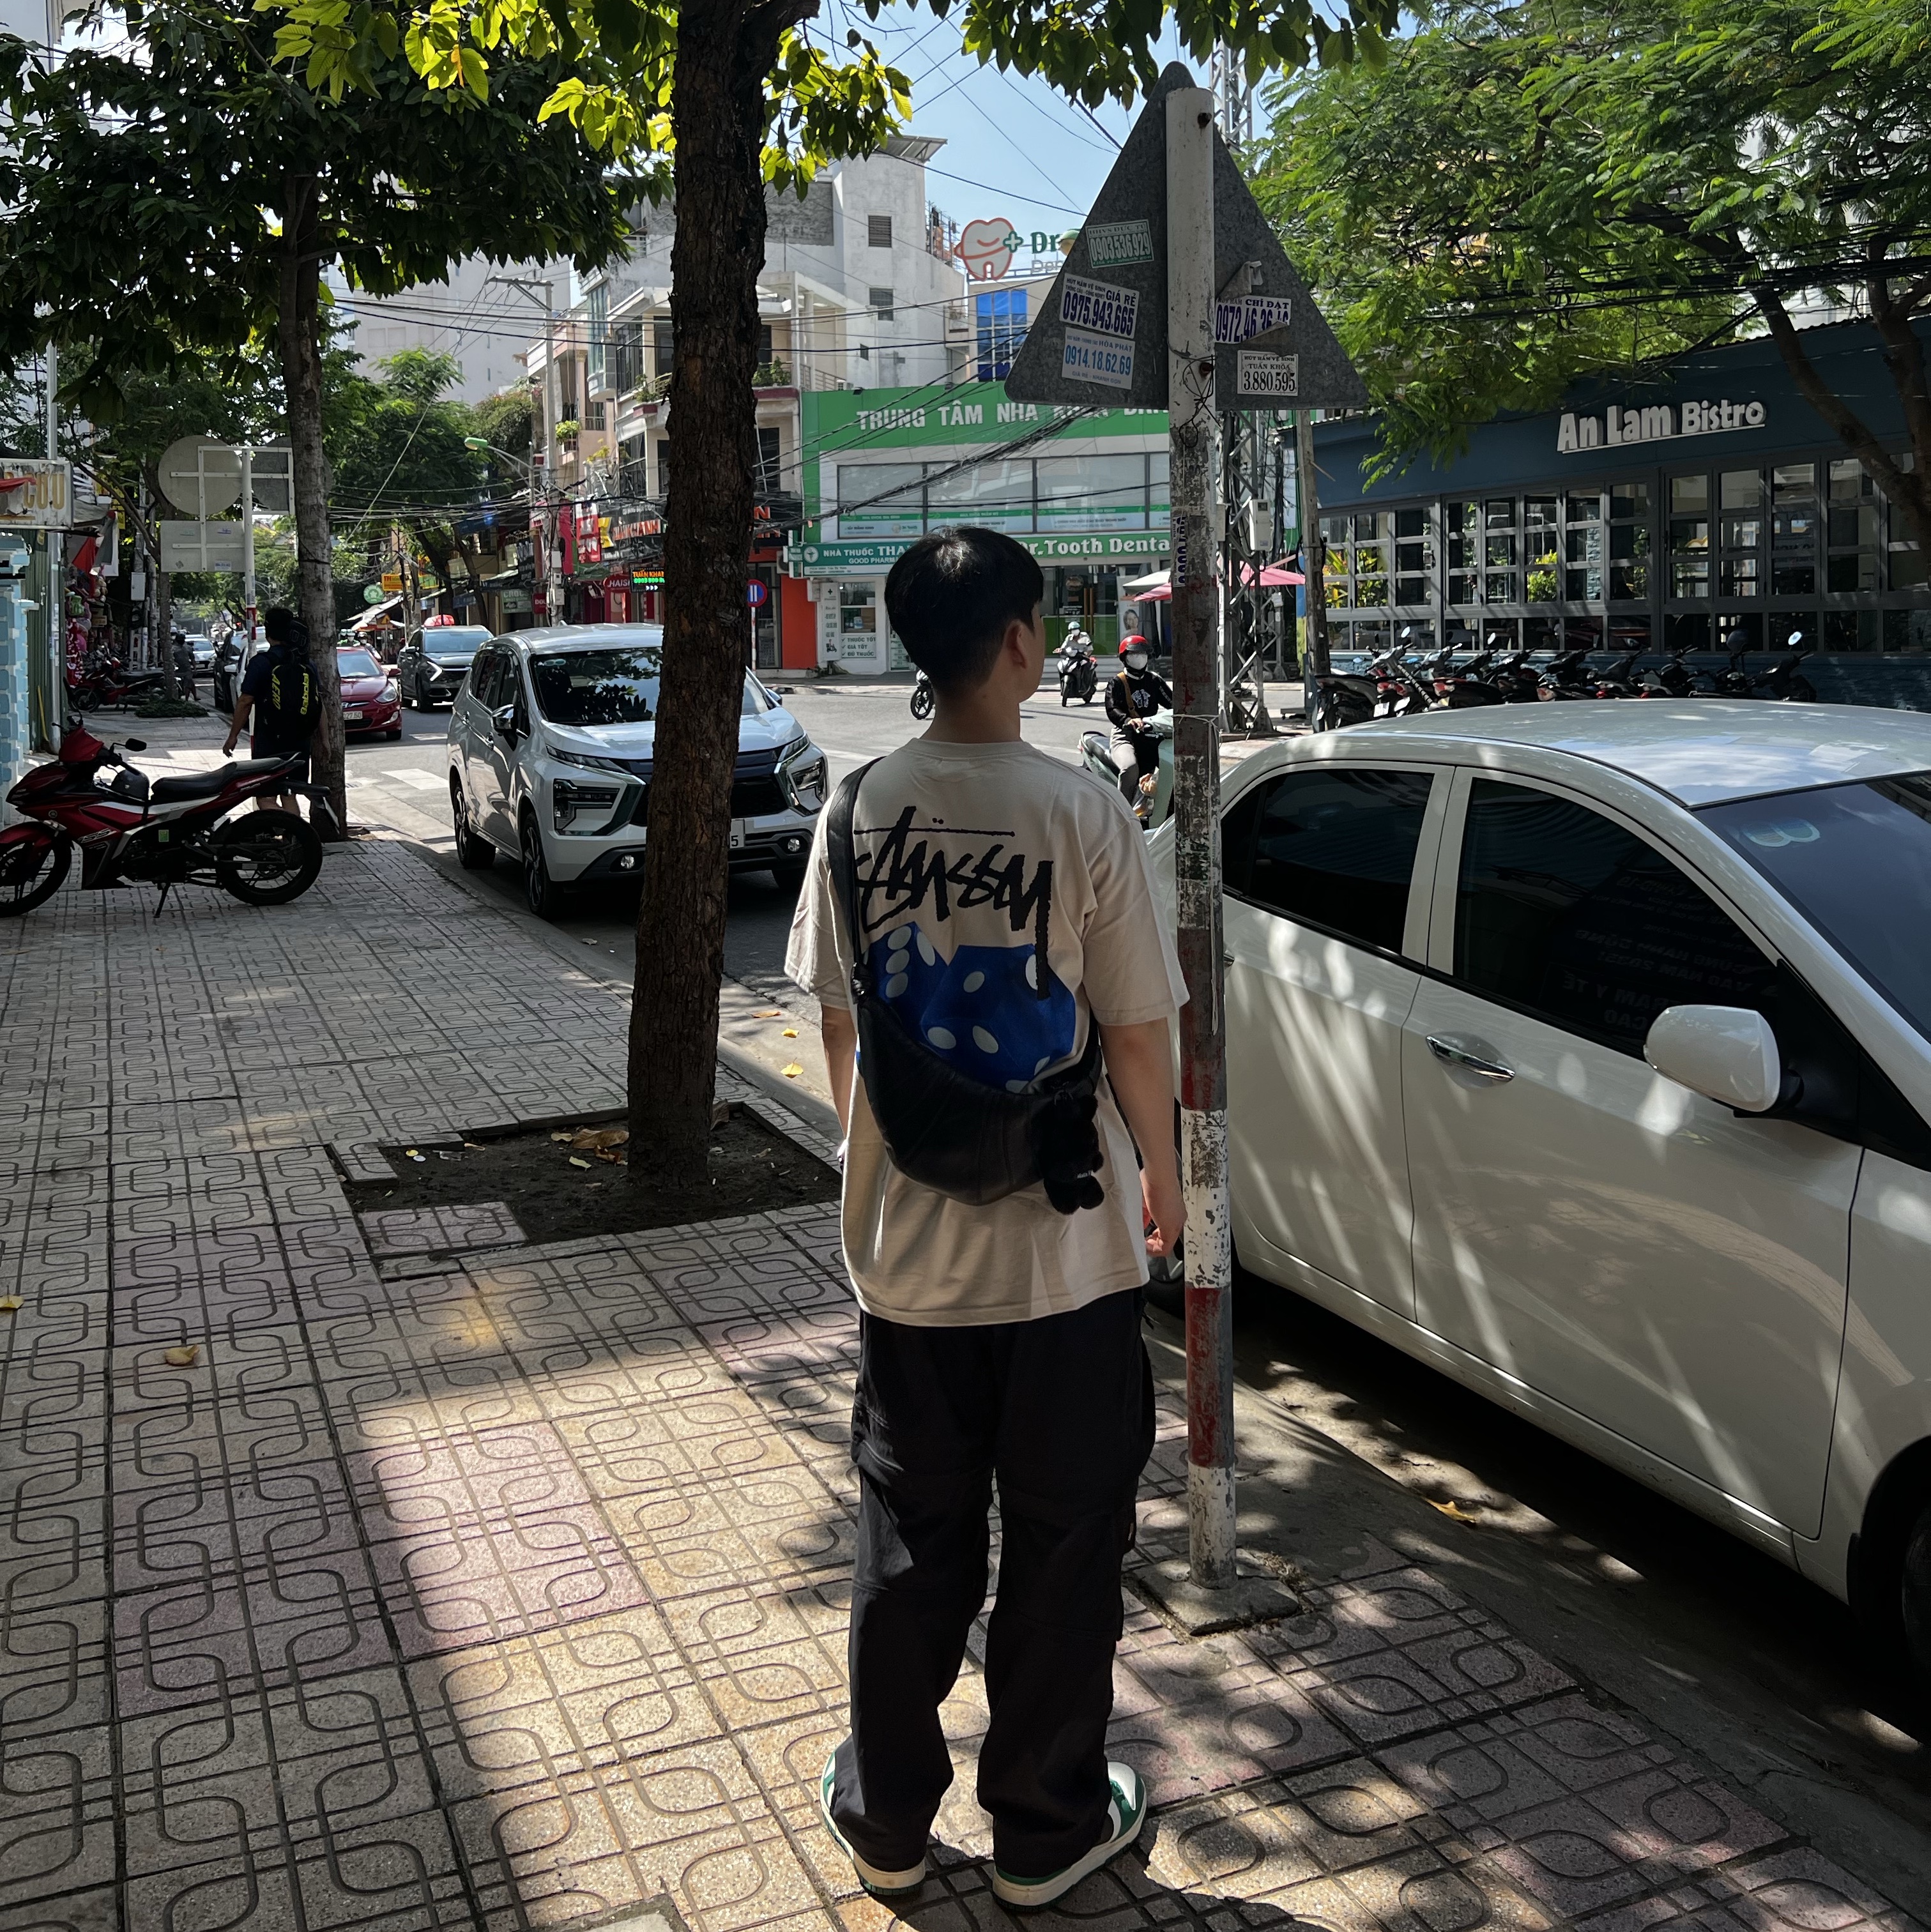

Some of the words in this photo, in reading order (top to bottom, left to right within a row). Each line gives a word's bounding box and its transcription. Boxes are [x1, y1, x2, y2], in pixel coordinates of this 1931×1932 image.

[1106, 289, 1121, 303] GIÁ
[1124, 293, 1136, 307] RẺ
[1062, 291, 1135, 337] 0975.943.665
[1065, 344, 1131, 376] 0914.18.62.69
[1244, 371, 1295, 392] 3.880.595
[857, 407, 926, 430] TRUNG
[938, 399, 983, 426] TÂM
[997, 402, 1039, 423] NHA
[1557, 413, 1603, 452] An
[1607, 405, 1677, 445] Lam
[1682, 399, 1766, 434] Bistro
[823, 547, 842, 557] NHÀ
[843, 547, 874, 556] THUỐC
[877, 544, 912, 556] THA
